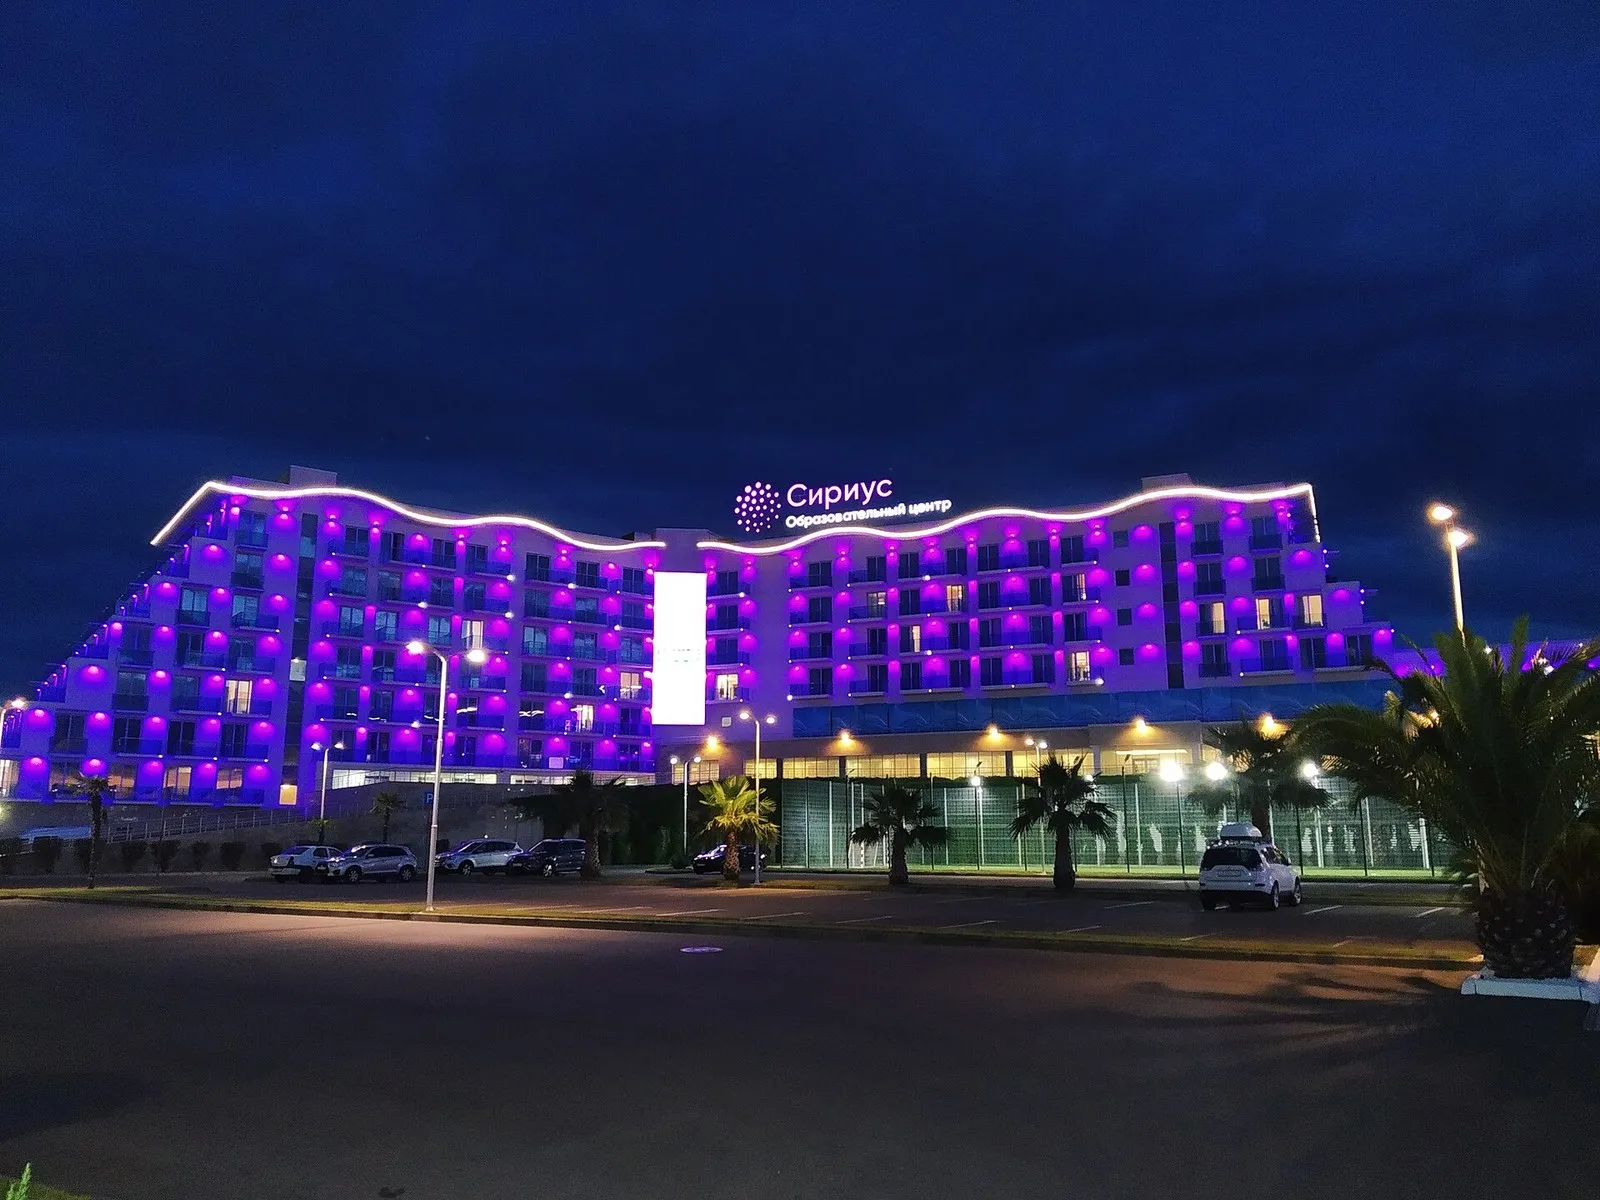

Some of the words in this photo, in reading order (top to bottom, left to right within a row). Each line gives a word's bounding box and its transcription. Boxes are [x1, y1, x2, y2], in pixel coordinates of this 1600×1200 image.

[786, 479, 893, 510] Сириус
[785, 503, 906, 529] Образовательный
[908, 499, 953, 515] центр
